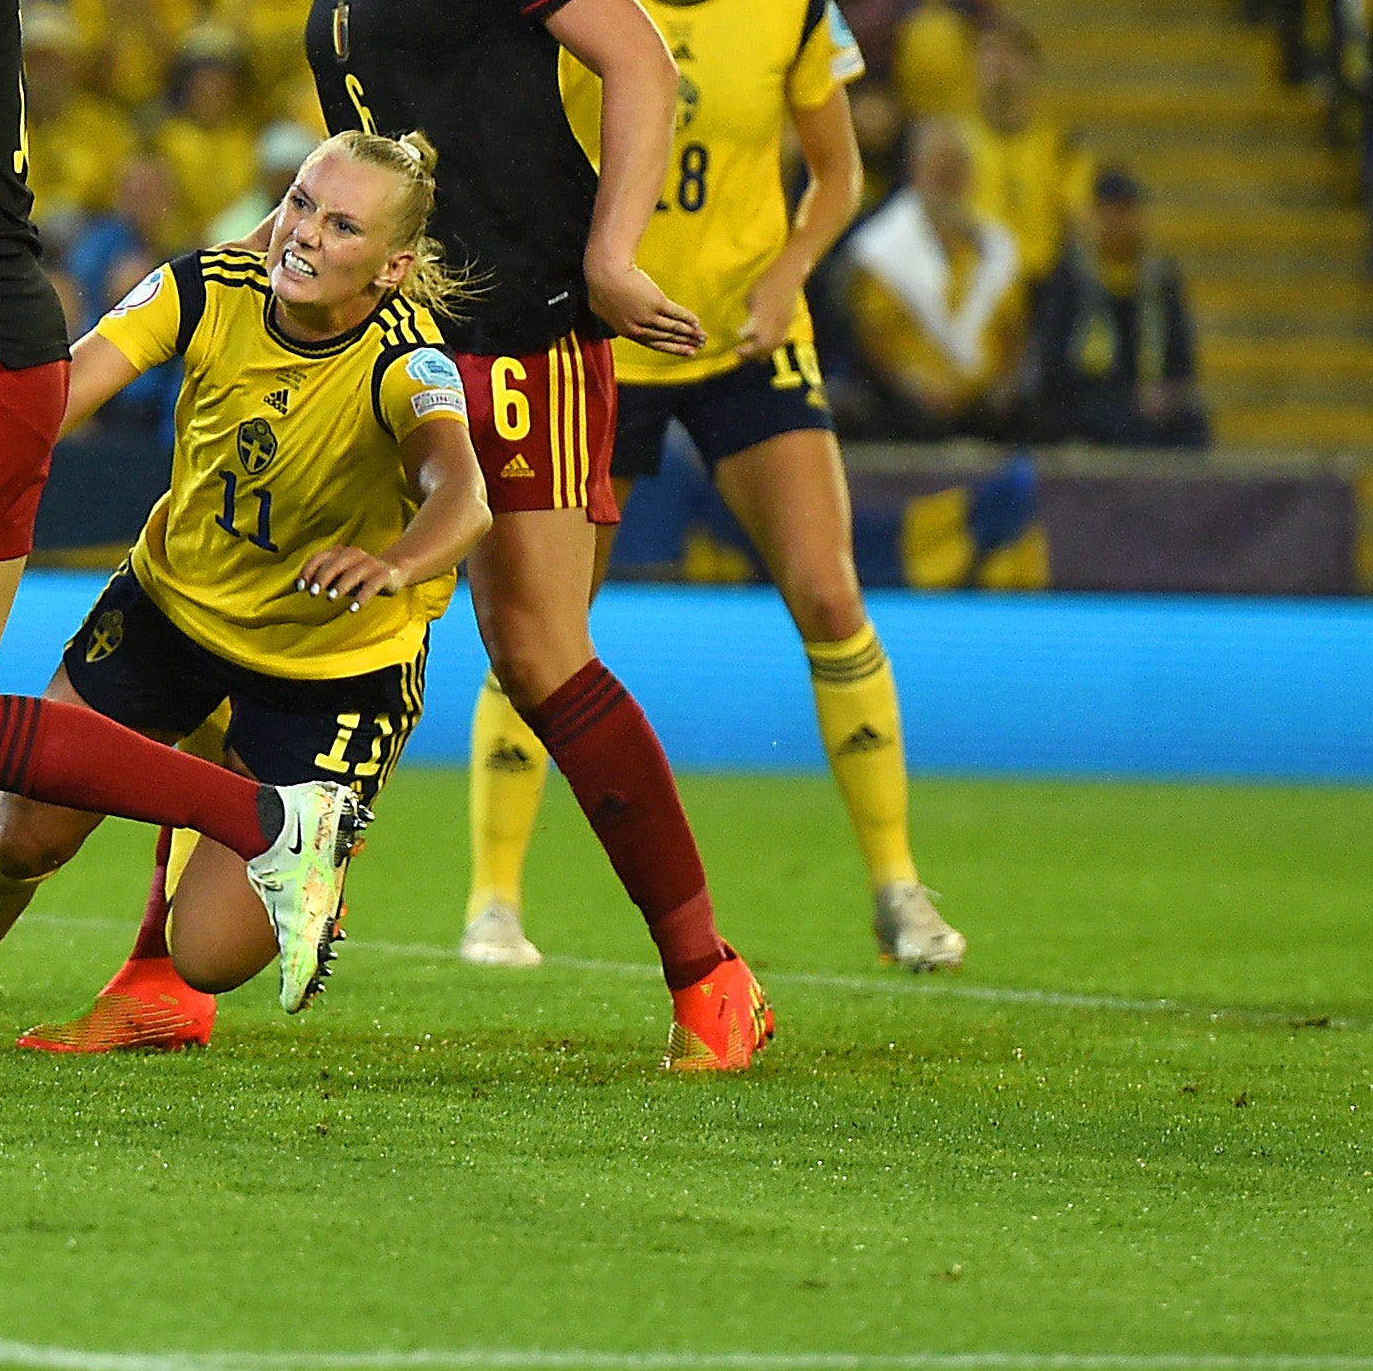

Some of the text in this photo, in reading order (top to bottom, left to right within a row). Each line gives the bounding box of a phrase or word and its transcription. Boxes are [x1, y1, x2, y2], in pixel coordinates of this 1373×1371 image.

[490, 356, 531, 441] 6
[214, 470, 279, 553] 11
[314, 713, 394, 776] 11
